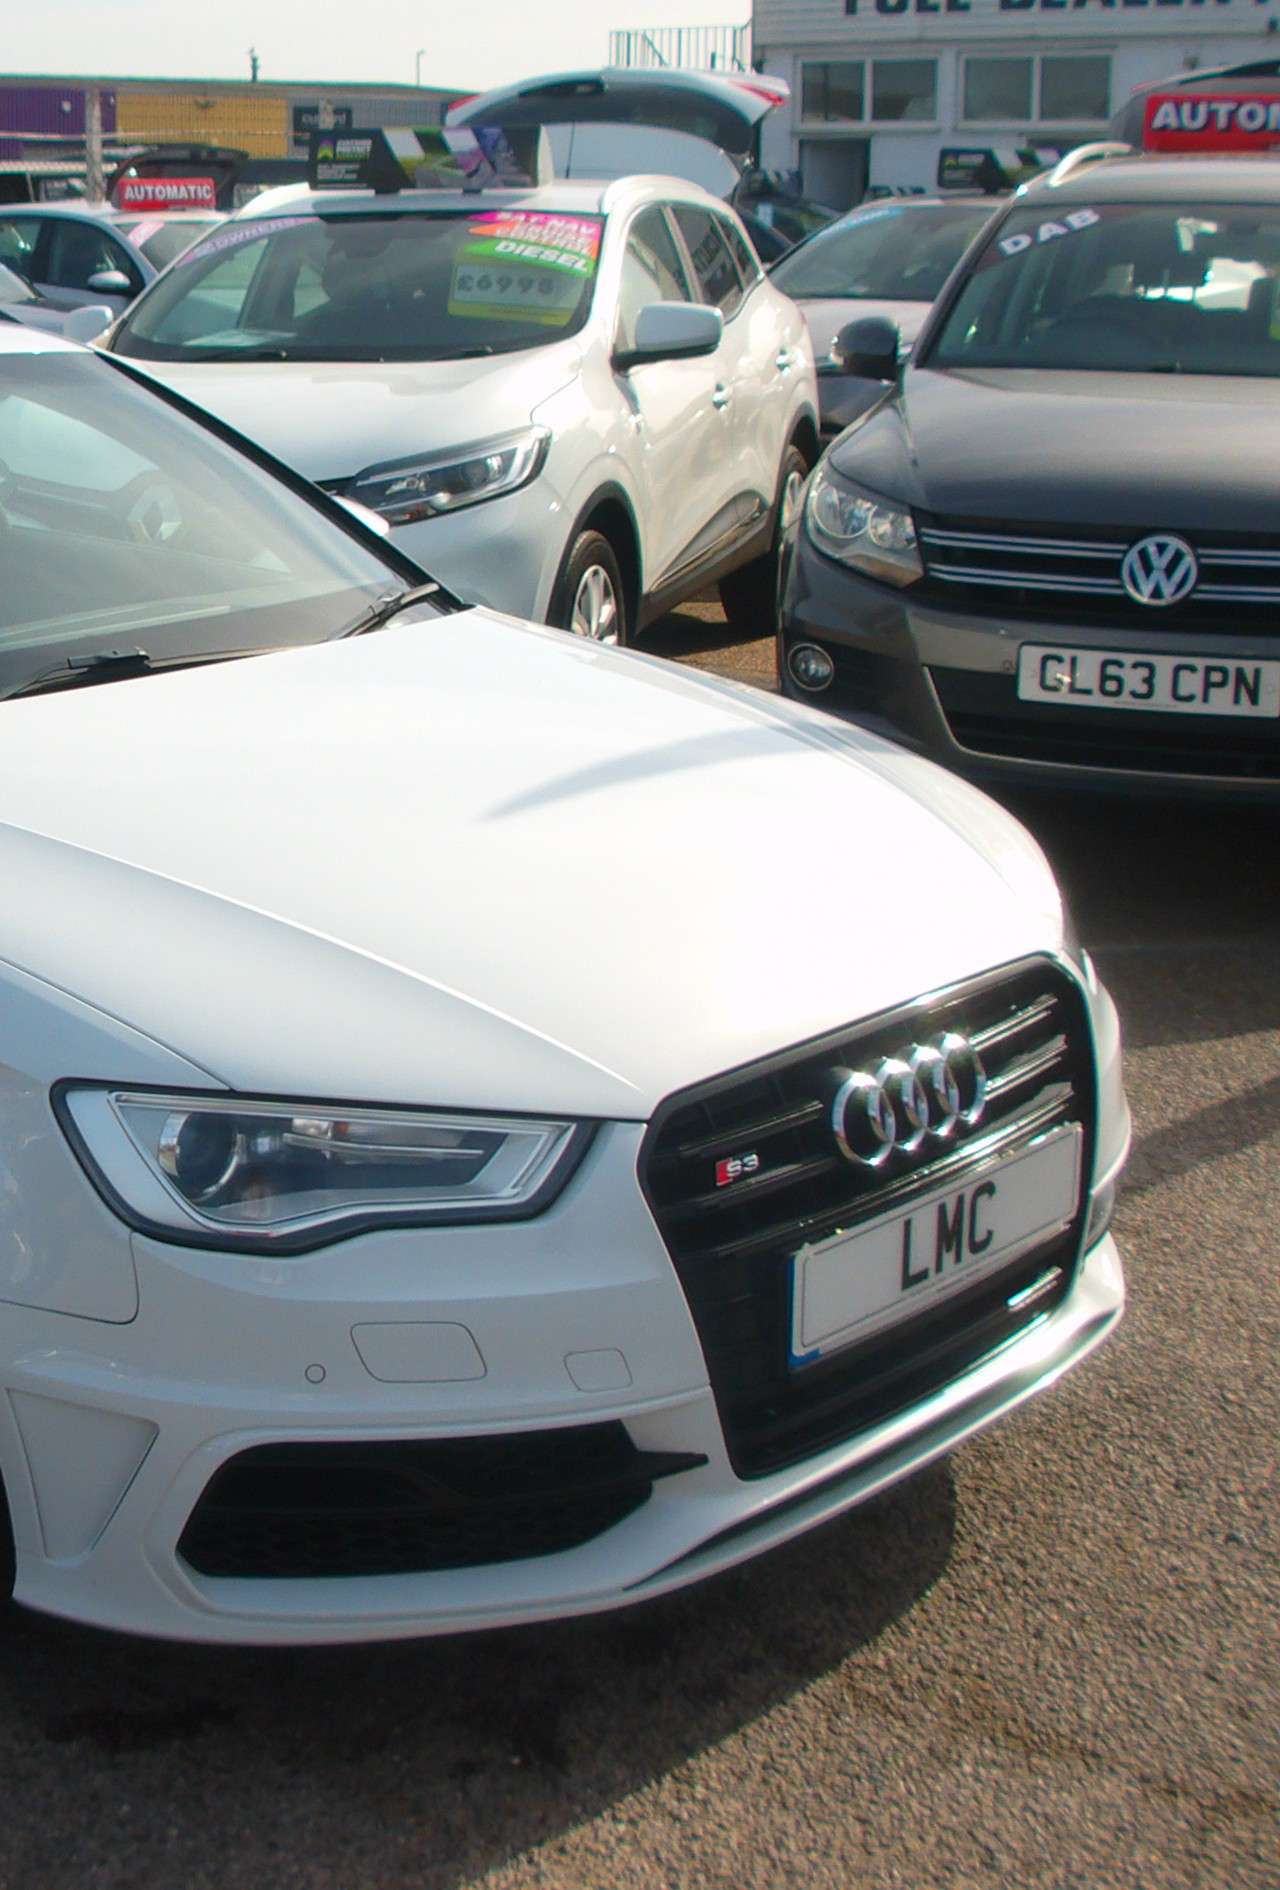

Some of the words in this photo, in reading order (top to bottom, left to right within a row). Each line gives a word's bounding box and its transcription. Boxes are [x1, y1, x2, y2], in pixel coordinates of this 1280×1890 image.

[124, 184, 213, 201] AUTOMATIC
[999, 208, 1101, 256] DAB
[495, 239, 588, 273] DIESEL
[1171, 663, 1262, 707] CPN
[726, 1153, 759, 1177] S3
[900, 1180, 996, 1290] LMC
